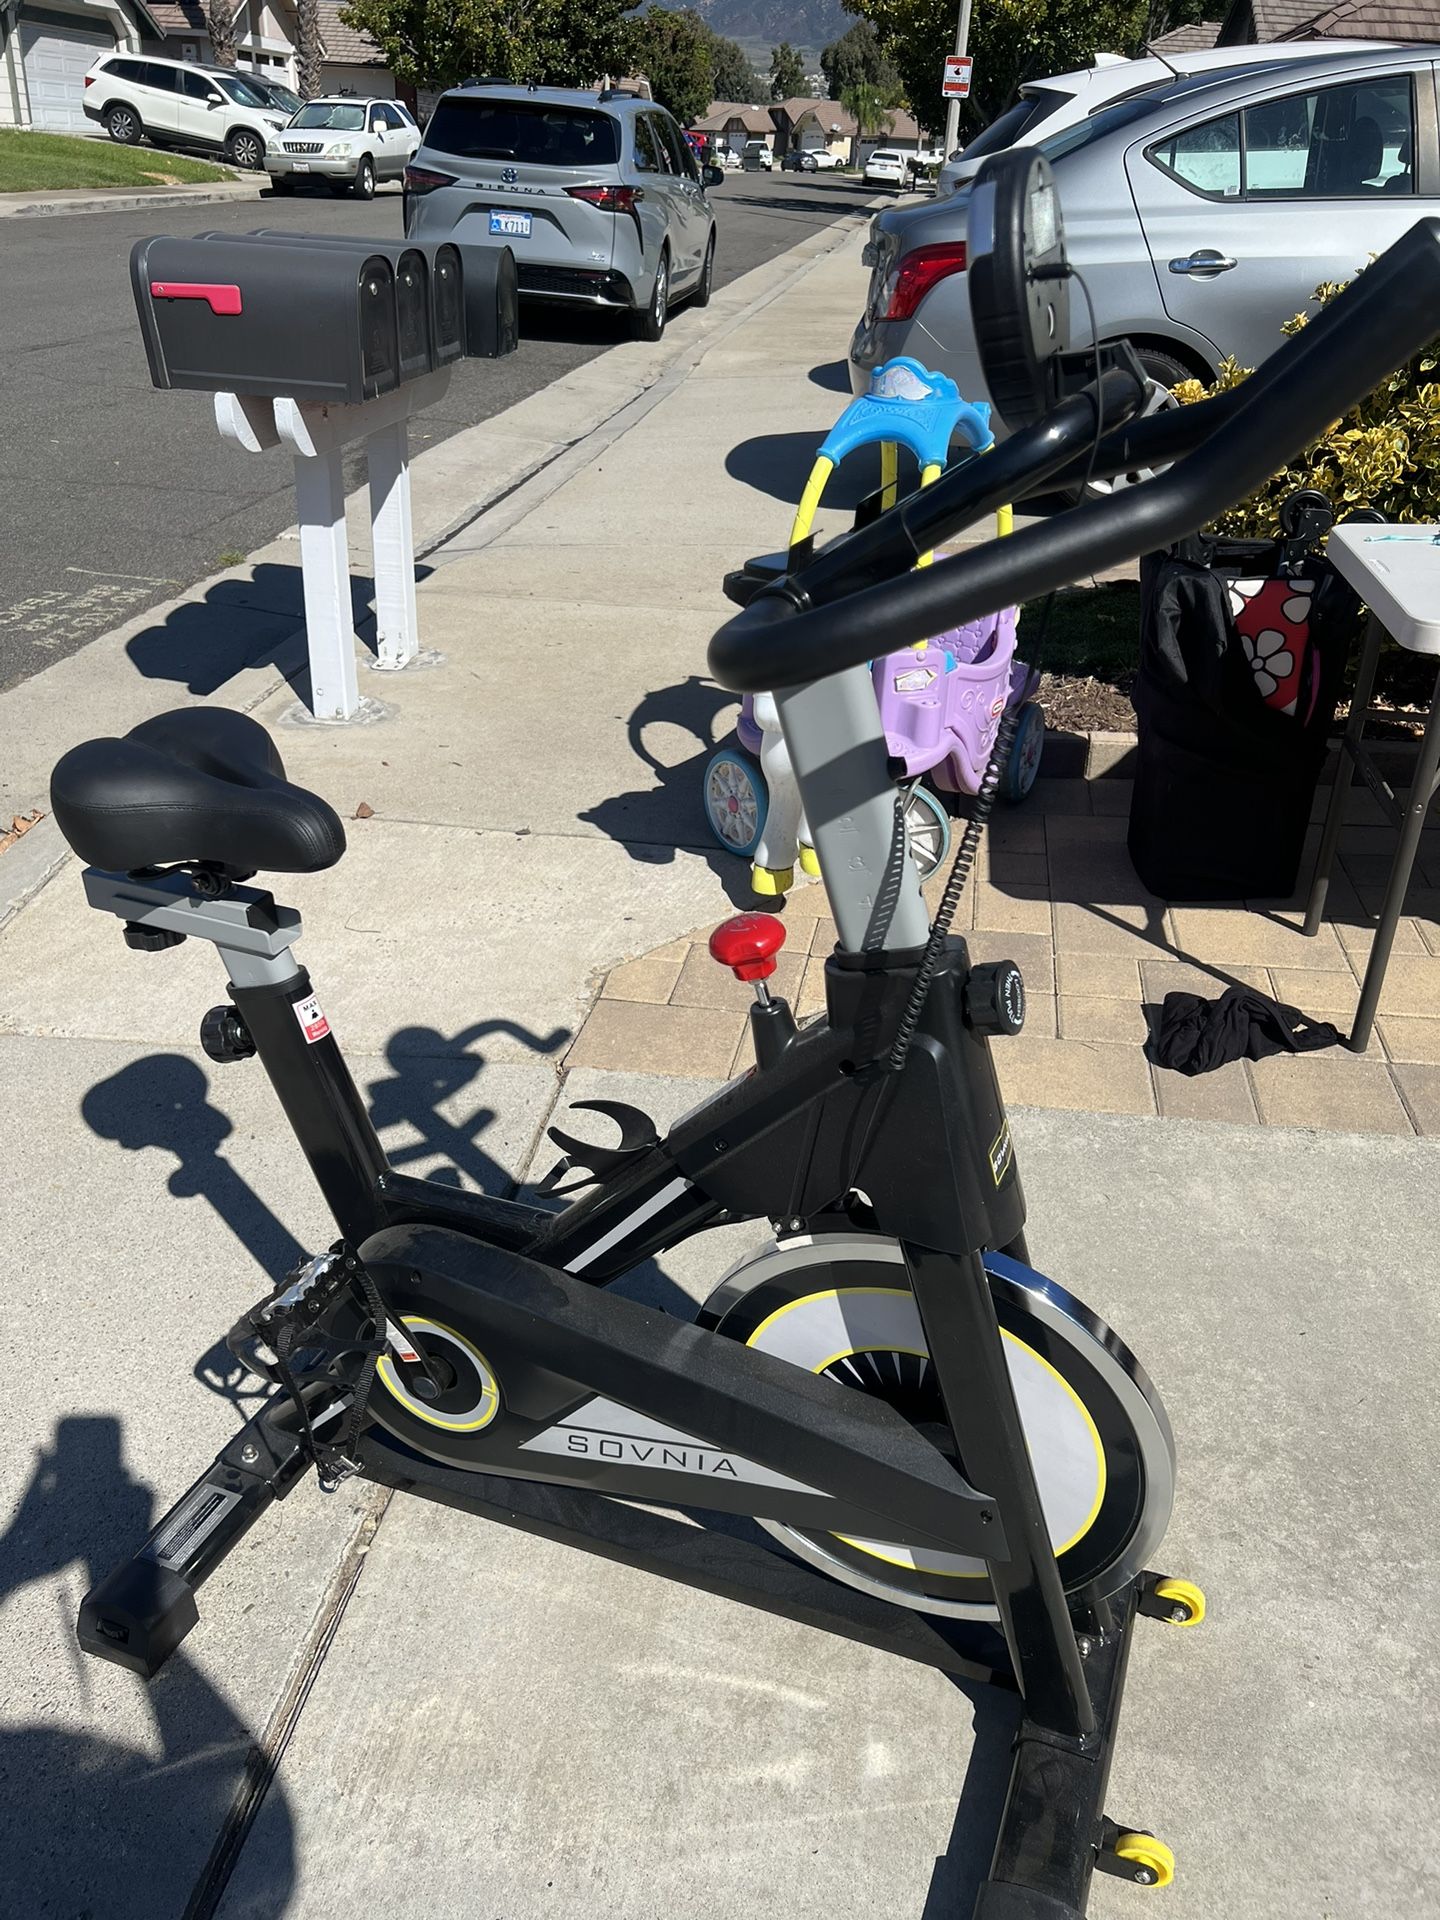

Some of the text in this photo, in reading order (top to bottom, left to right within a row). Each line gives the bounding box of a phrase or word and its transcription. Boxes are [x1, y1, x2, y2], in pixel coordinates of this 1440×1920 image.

[475, 183, 546, 194] SIENNA
[1005, 1000, 1015, 1023] PULL
[568, 1435, 738, 1477] SOVNIA
